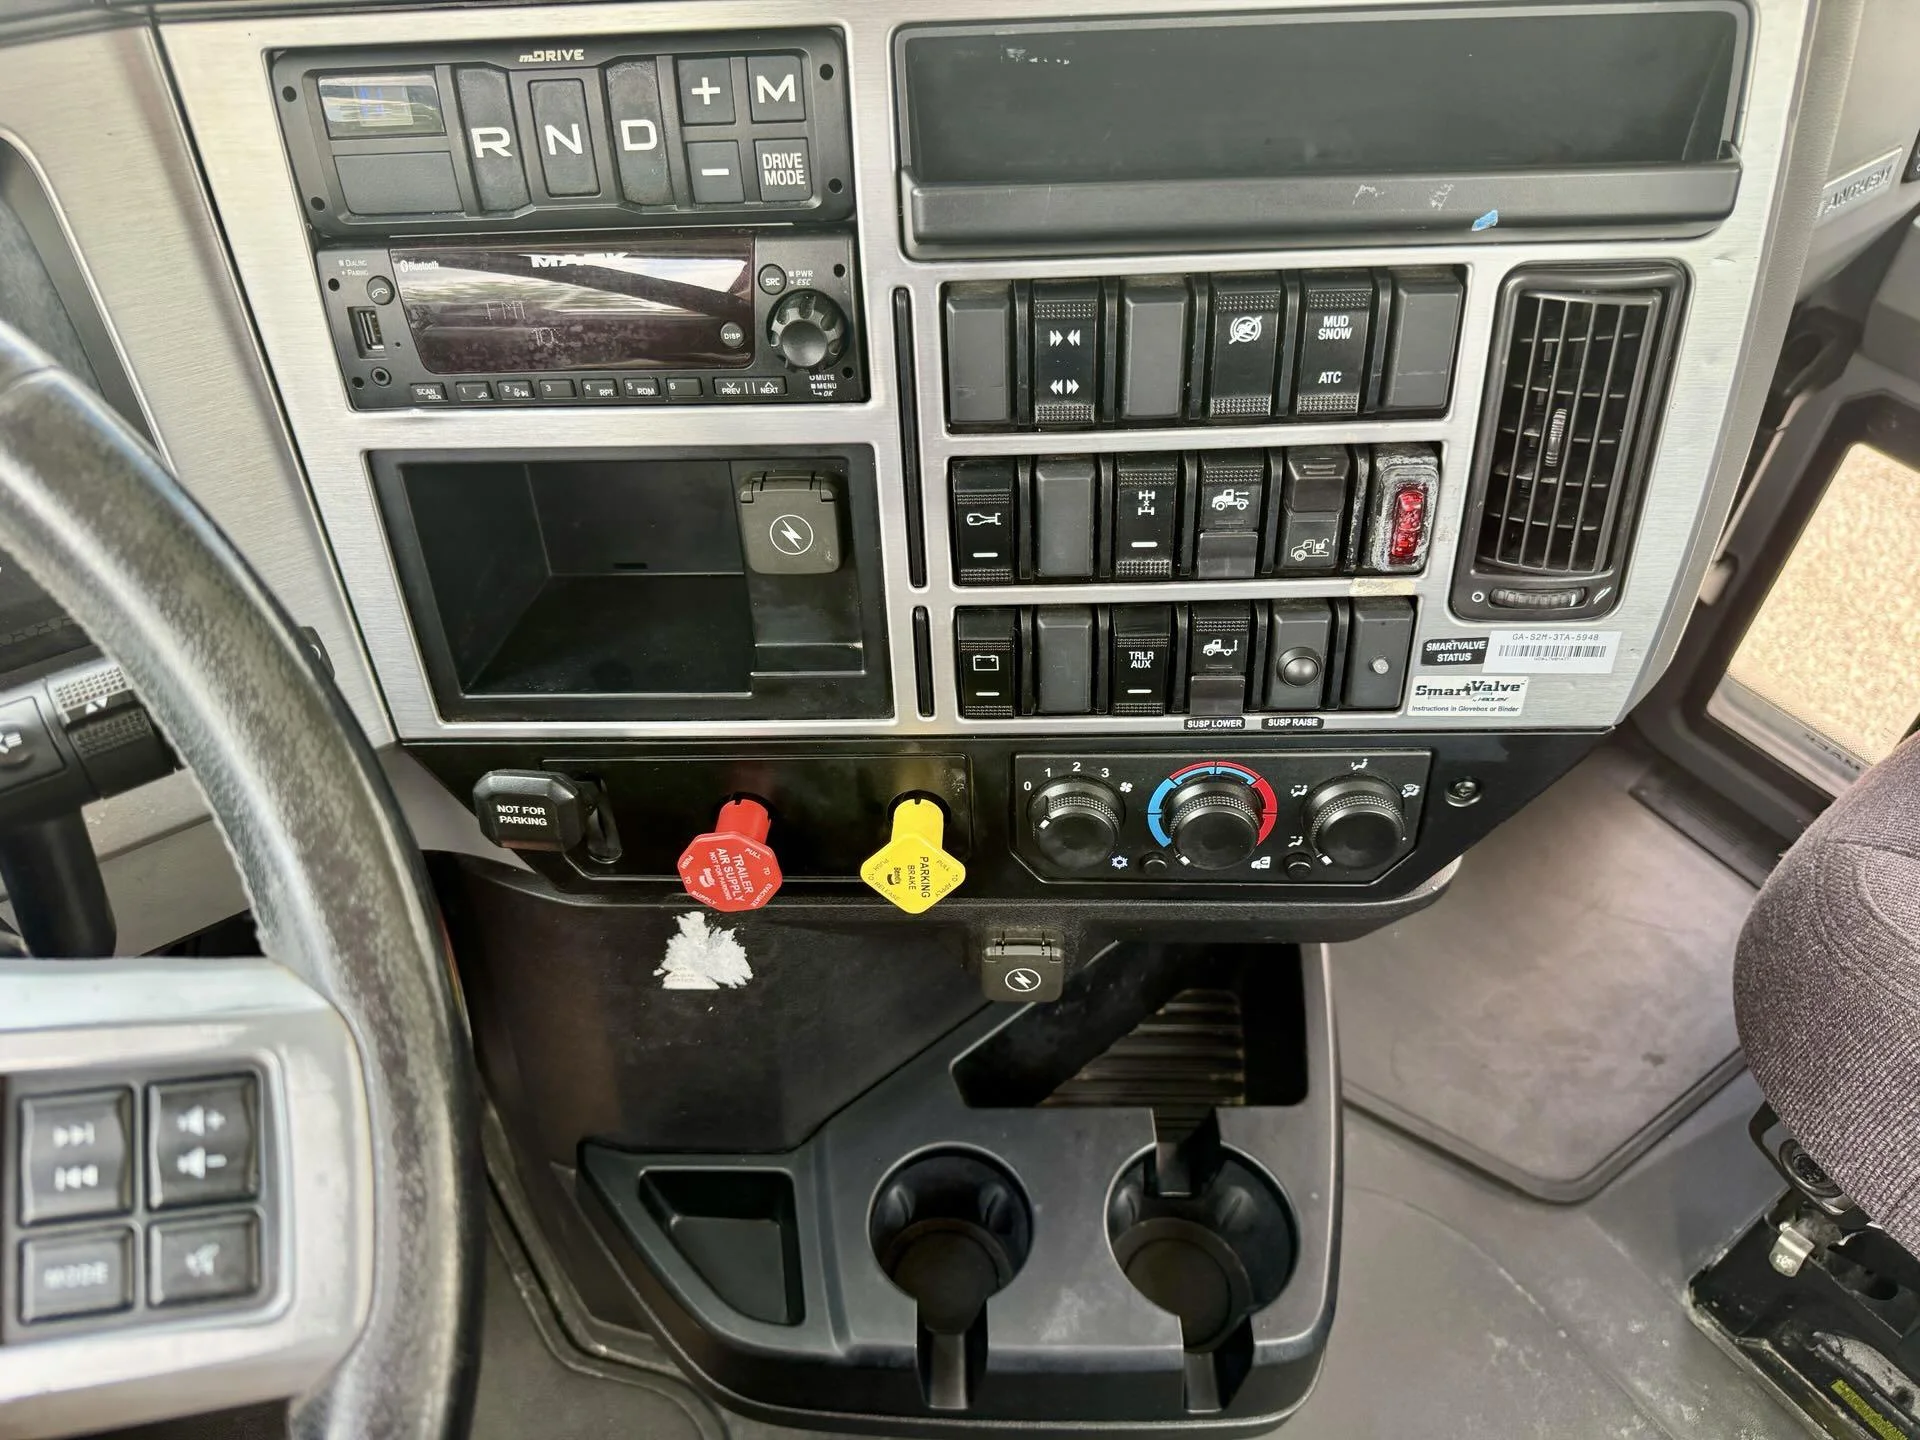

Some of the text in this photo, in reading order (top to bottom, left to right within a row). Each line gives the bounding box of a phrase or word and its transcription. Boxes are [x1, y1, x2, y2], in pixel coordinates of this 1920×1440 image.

[519, 49, 584, 63] mDRIVE
[757, 74, 796, 104] M
[544, 123, 583, 155] N
[620, 119, 658, 151] D
[470, 126, 513, 158] R
[762, 152, 803, 170] DRIVE
[764, 169, 806, 187] MODE
[408, 260, 439, 271] Bluetooth
[531, 252, 629, 268] MAK
[796, 270, 813, 278] PWR
[765, 277, 780, 286] SRC
[1323, 315, 1349, 328] MUD
[724, 332, 741, 340] DISP
[1318, 327, 1352, 340] SNOW
[1318, 371, 1342, 384] ATC
[416, 388, 435, 396] SCAN
[599, 389, 614, 397] RPT
[722, 387, 741, 395] PREV
[1426, 640, 1487, 652] SMARTVALVE
[1129, 651, 1154, 660] TRLR
[1437, 652, 1472, 663] STATUS
[1130, 660, 1152, 669] AUX
[1187, 719, 1243, 728] SUSP LOWER
[1268, 718, 1319, 727] SUSP RAISE
[1044, 767, 1051, 778] 1
[1072, 761, 1081, 772] 2
[1101, 767, 1110, 778] 3
[1023, 781, 1032, 791] 0
[496, 804, 546, 816] NOT FOR
[499, 815, 548, 826] PARKING
[708, 851, 719, 865] NOT
[714, 864, 723, 877] FOR
[745, 848, 761, 860] PULL
[763, 867, 771, 876] TO
[716, 848, 746, 901] AIR SUPPLY
[732, 853, 754, 894] TRAILER
[908, 864, 917, 890] BRAKE
[920, 856, 931, 898] PARKING
[685, 876, 692, 885] TO
[691, 890, 718, 905] SUPPLY
[44, 1260, 109, 1290] MODE
